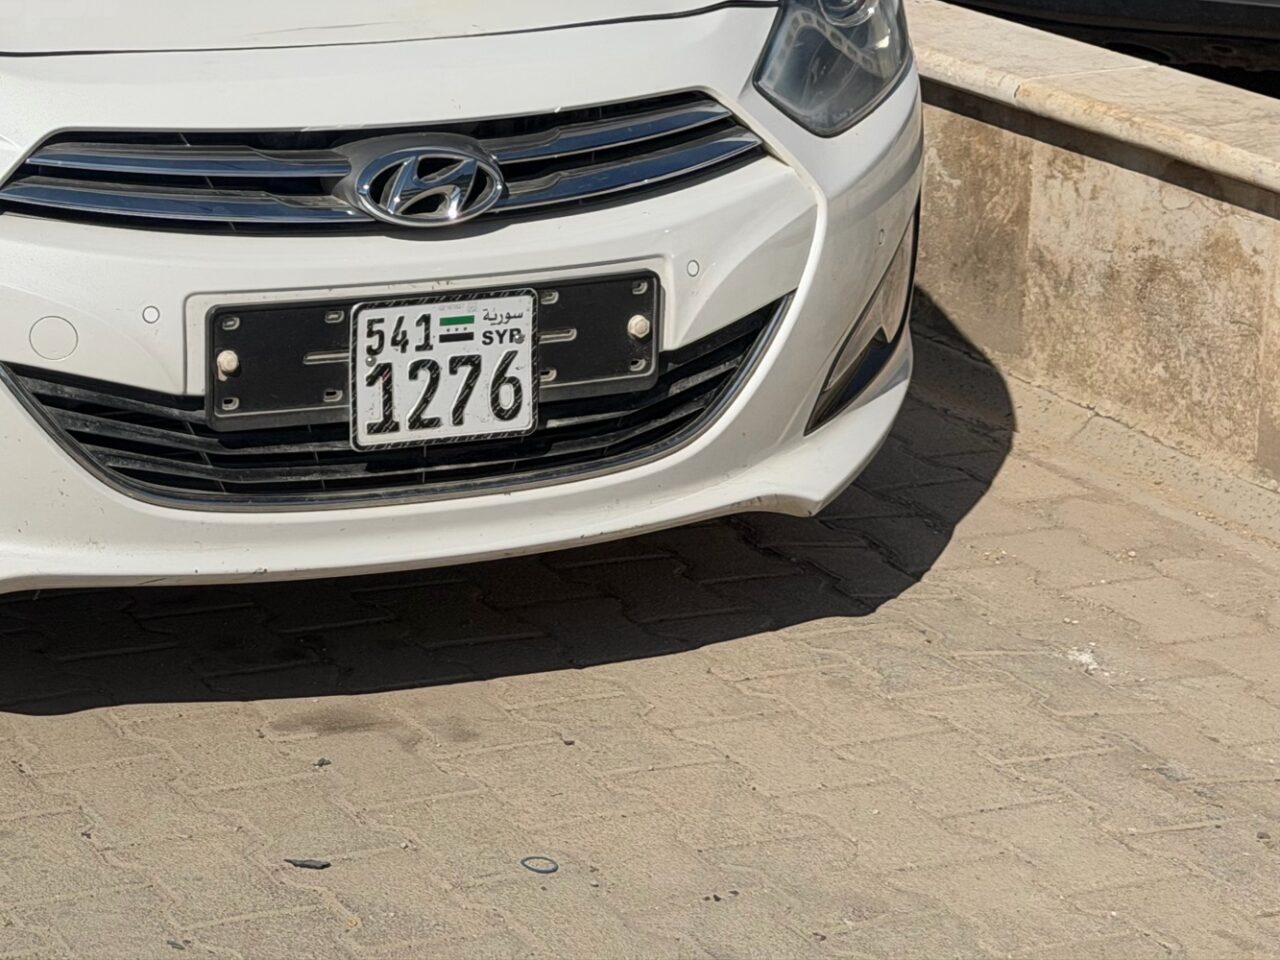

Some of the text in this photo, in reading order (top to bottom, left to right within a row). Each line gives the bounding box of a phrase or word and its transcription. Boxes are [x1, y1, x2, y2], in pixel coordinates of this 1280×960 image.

[482, 308, 524, 326] سورية
[365, 313, 434, 356] 541
[481, 327, 524, 346] SYR
[365, 350, 524, 435] 1276
